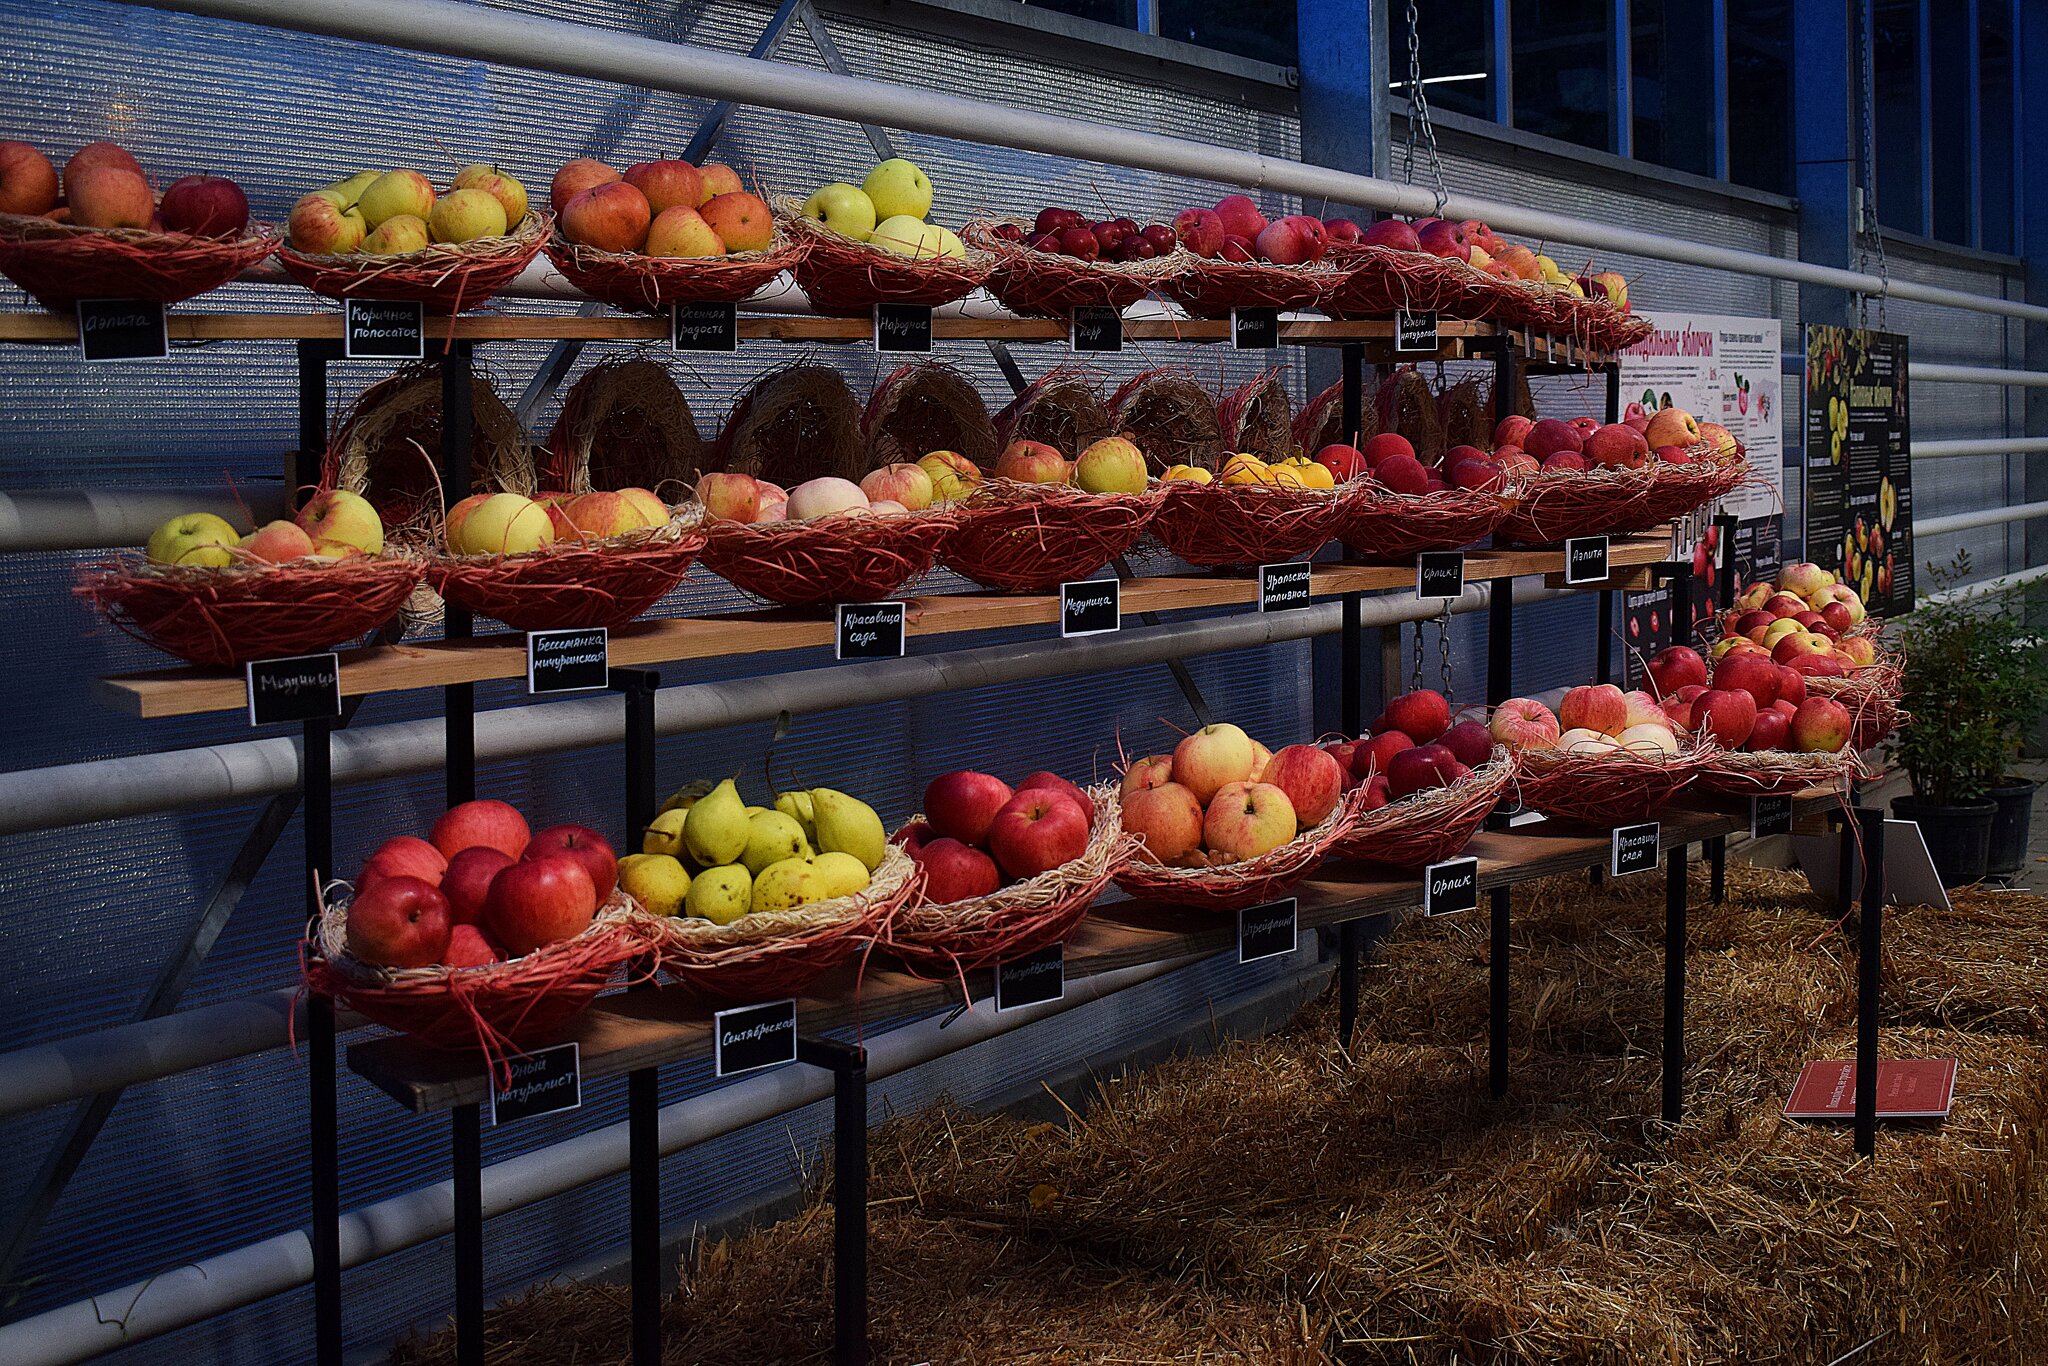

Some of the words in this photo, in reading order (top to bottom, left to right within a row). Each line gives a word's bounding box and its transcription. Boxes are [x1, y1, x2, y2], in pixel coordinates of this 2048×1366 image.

[351, 306, 414, 327] Коричное
[680, 306, 726, 320] Осенняя
[679, 324, 724, 341] радость
[880, 317, 928, 336] Народное
[1265, 571, 1311, 591] Уральское
[1423, 567, 1452, 581] Орлик
[1064, 596, 1113, 616] Медуница
[1264, 589, 1308, 604] наливное
[844, 610, 901, 630] Красавица
[537, 635, 605, 652] Бессемянка
[849, 631, 878, 647] сада
[534, 651, 605, 673] мичуринская
[1432, 874, 1472, 897] Орлик
